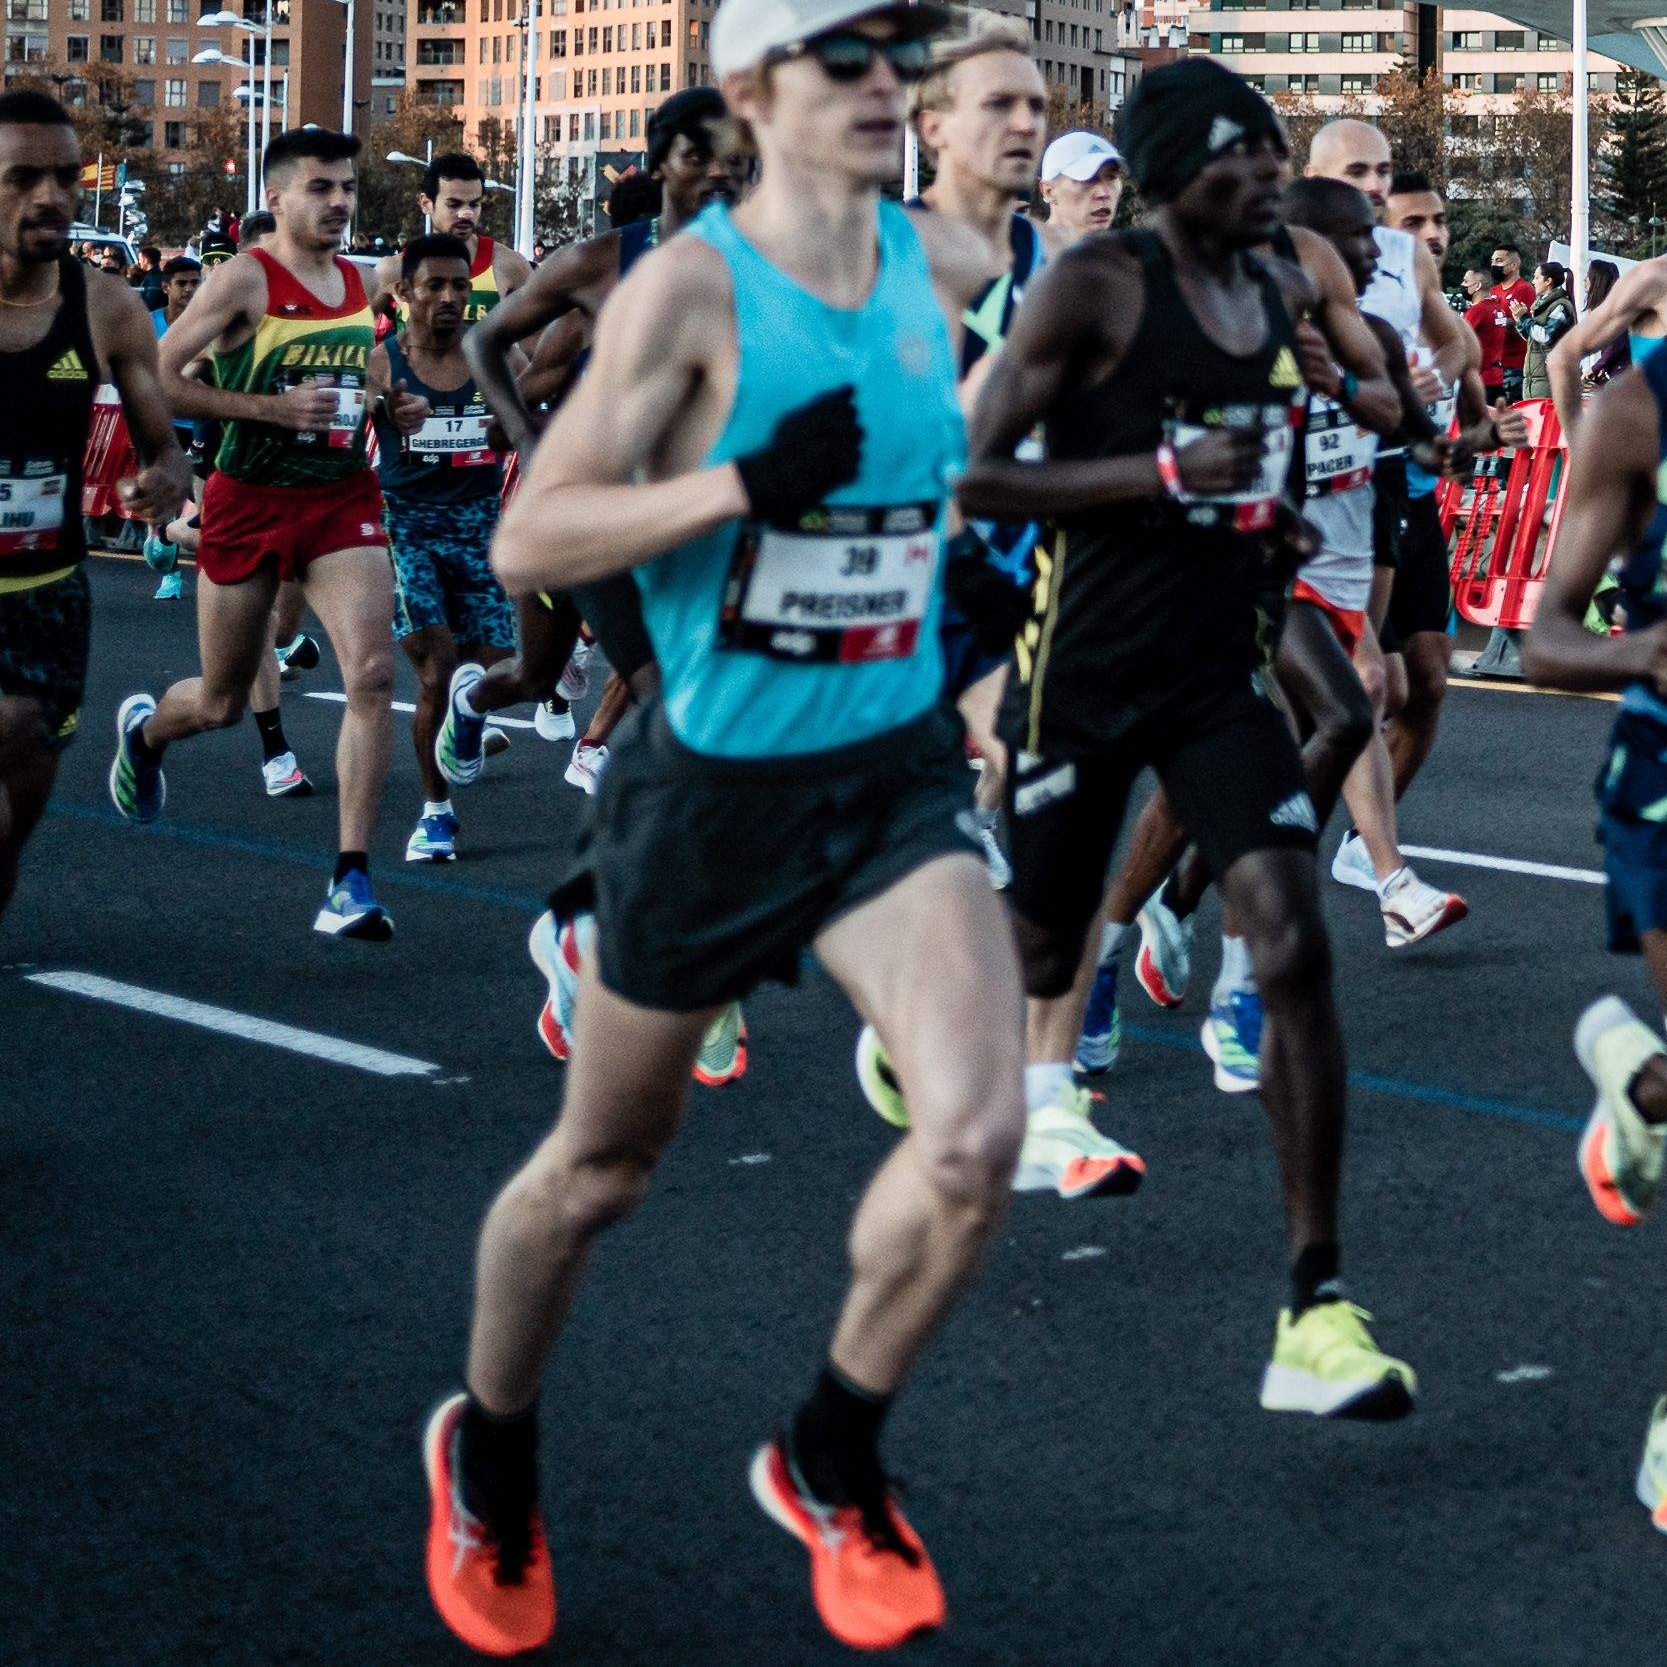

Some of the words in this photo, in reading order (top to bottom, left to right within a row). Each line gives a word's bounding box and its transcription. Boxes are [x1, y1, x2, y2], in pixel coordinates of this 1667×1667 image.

[445, 420, 464, 433] 17
[1318, 432, 1340, 452] 92
[1307, 454, 1354, 478] PACER
